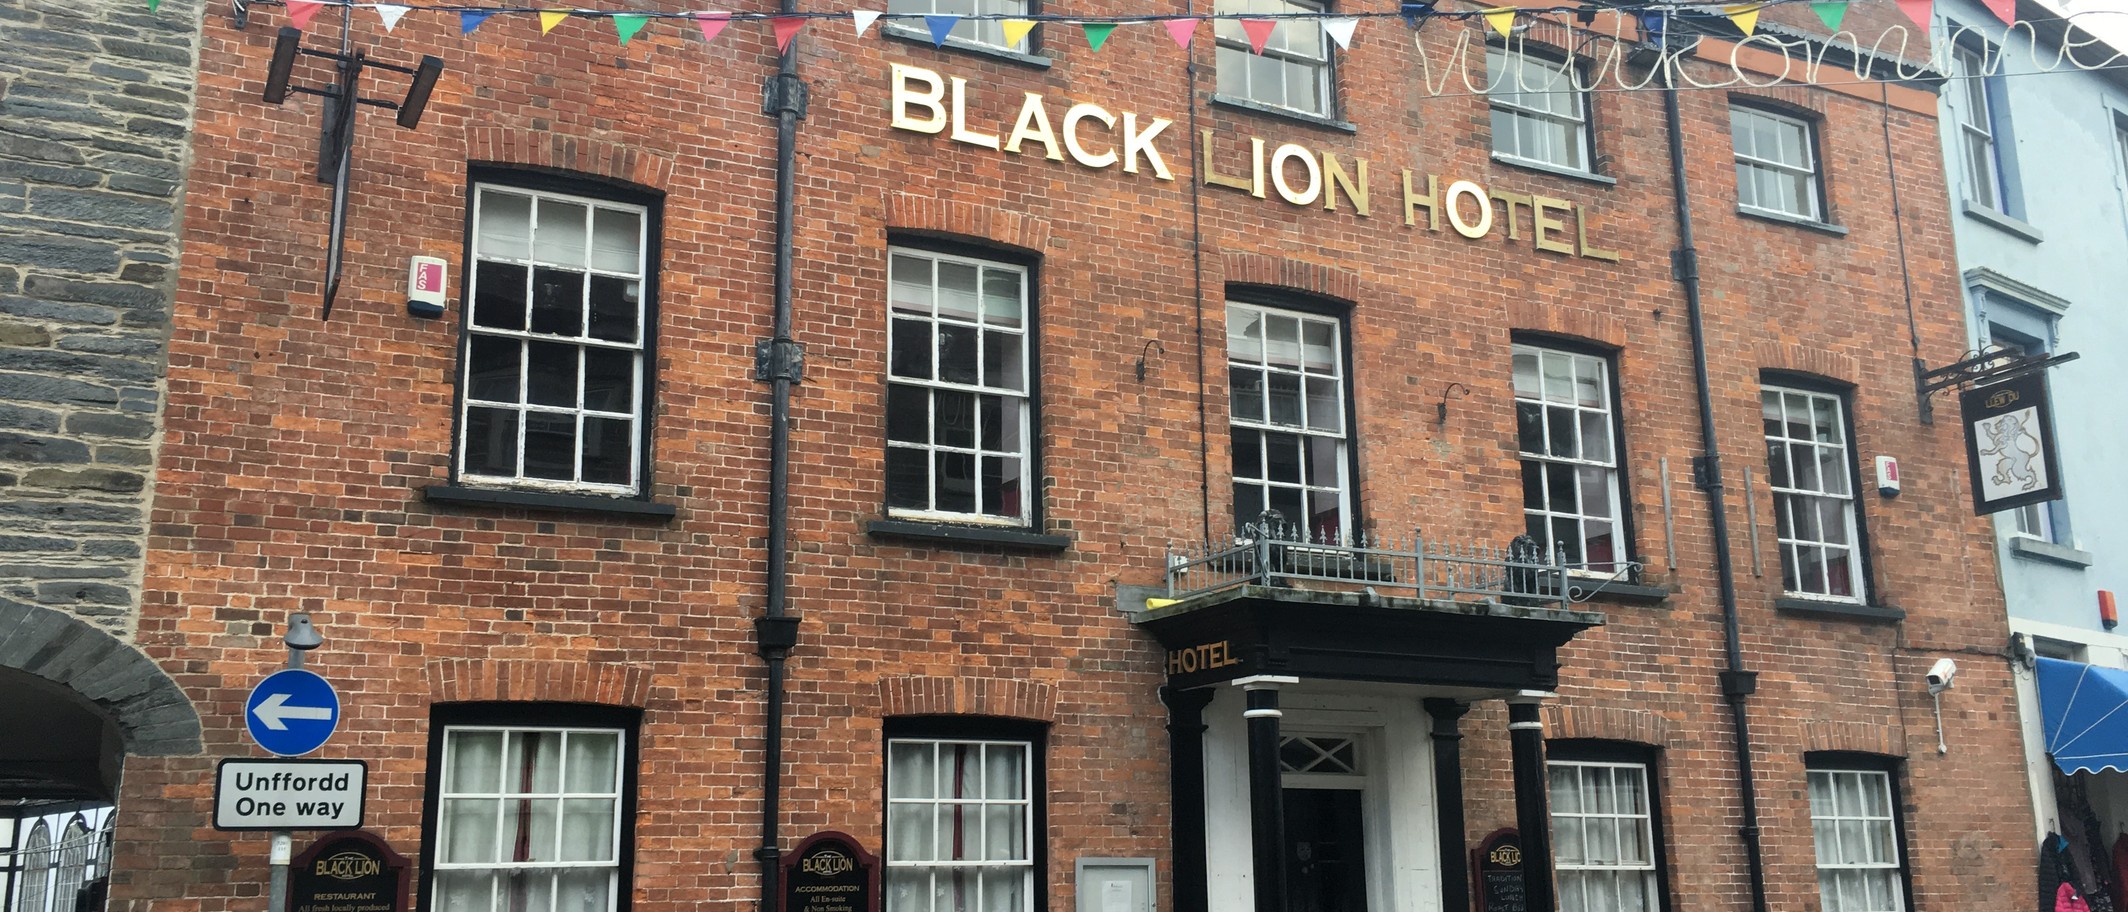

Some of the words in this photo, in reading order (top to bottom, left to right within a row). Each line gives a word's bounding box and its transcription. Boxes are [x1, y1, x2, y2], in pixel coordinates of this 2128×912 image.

[889, 62, 1175, 181] BLACK
[1200, 129, 1370, 217] LION
[1401, 169, 1620, 263] HOTEL
[417, 263, 428, 290] FAS
[1168, 640, 1239, 675] HOTEL
[236, 772, 349, 791] Unffordd
[235, 797, 286, 816] One
[296, 801, 344, 820] way
[1490, 851, 1511, 863] BLACK
[1511, 851, 1521, 863] LIO
[315, 859, 353, 876] BLACK
[354, 859, 381, 876] LION
[802, 858, 832, 873] BLACK
[833, 857, 853, 872] LION
[1487, 874, 1523, 882] TRADITION
[795, 885, 860, 893] ACCOMMODATION
[313, 892, 377, 901] RESTAURANT
[810, 895, 820, 903] All
[821, 895, 846, 903] En-suite
[298, 904, 310, 912] All
[312, 904, 330, 912] fresh
[331, 903, 356, 912] locally
[357, 903, 390, 912] produced
[825, 904, 853, 912] Smoking
